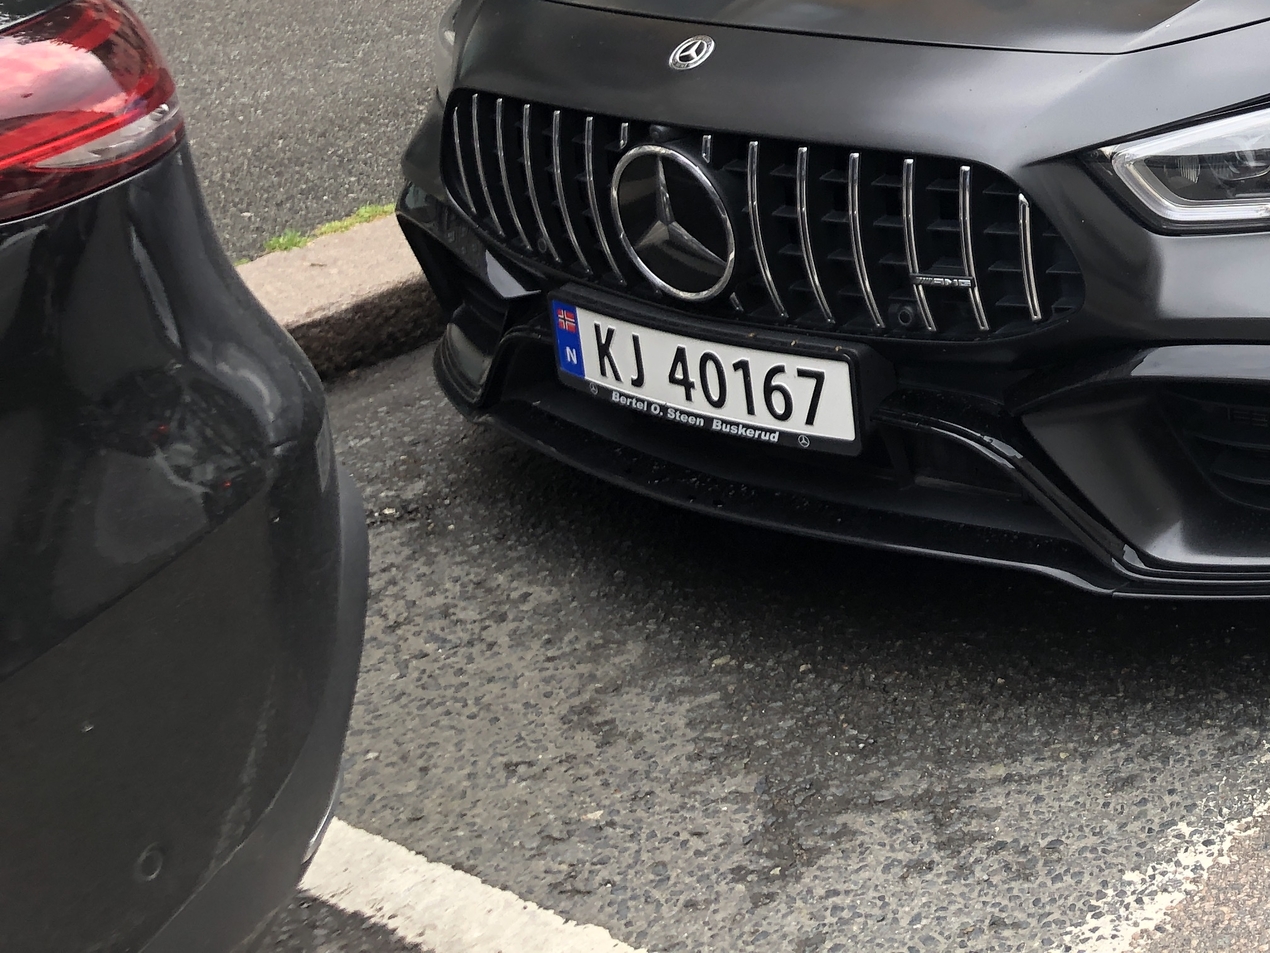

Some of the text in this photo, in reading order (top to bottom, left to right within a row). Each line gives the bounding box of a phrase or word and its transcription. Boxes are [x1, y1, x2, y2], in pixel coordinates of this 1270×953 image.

[565, 345, 578, 365] N
[593, 322, 826, 427] KJ 40167
[611, 390, 780, 443] Bertel O. Steen Buskerud
